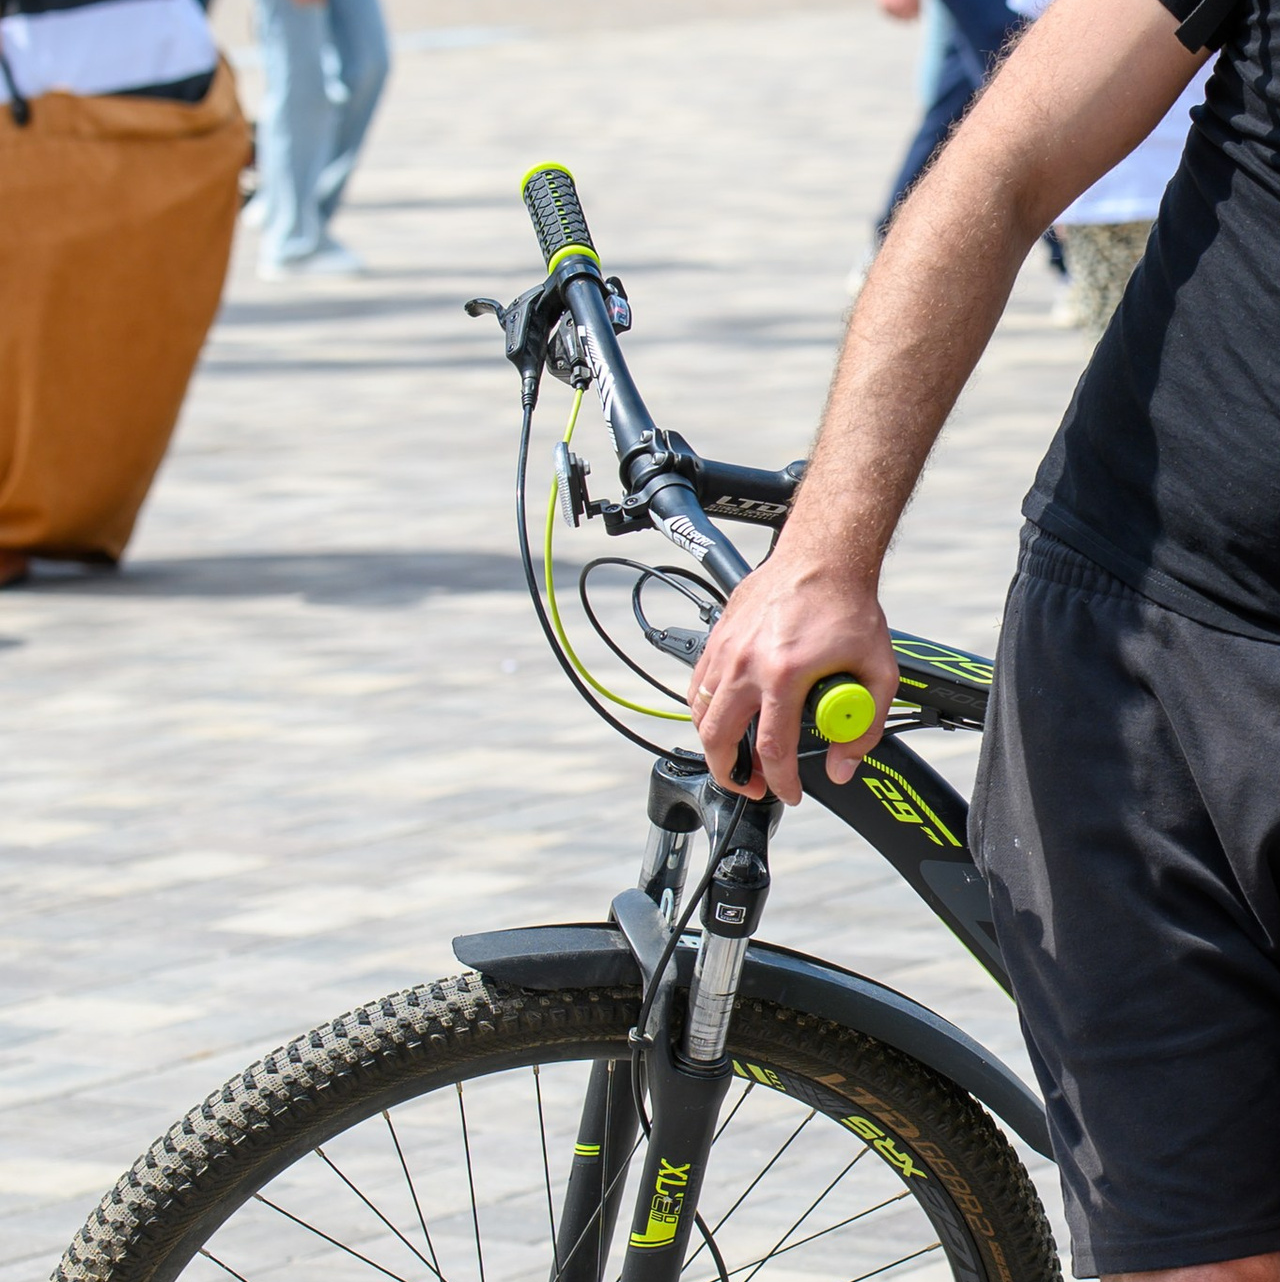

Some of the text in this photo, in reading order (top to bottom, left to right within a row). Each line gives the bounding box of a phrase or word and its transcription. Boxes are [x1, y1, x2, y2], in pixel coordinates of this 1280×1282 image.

[715, 495, 788, 514] LTD
[686, 529, 716, 547] SPORT
[841, 1116, 928, 1178] XR5
